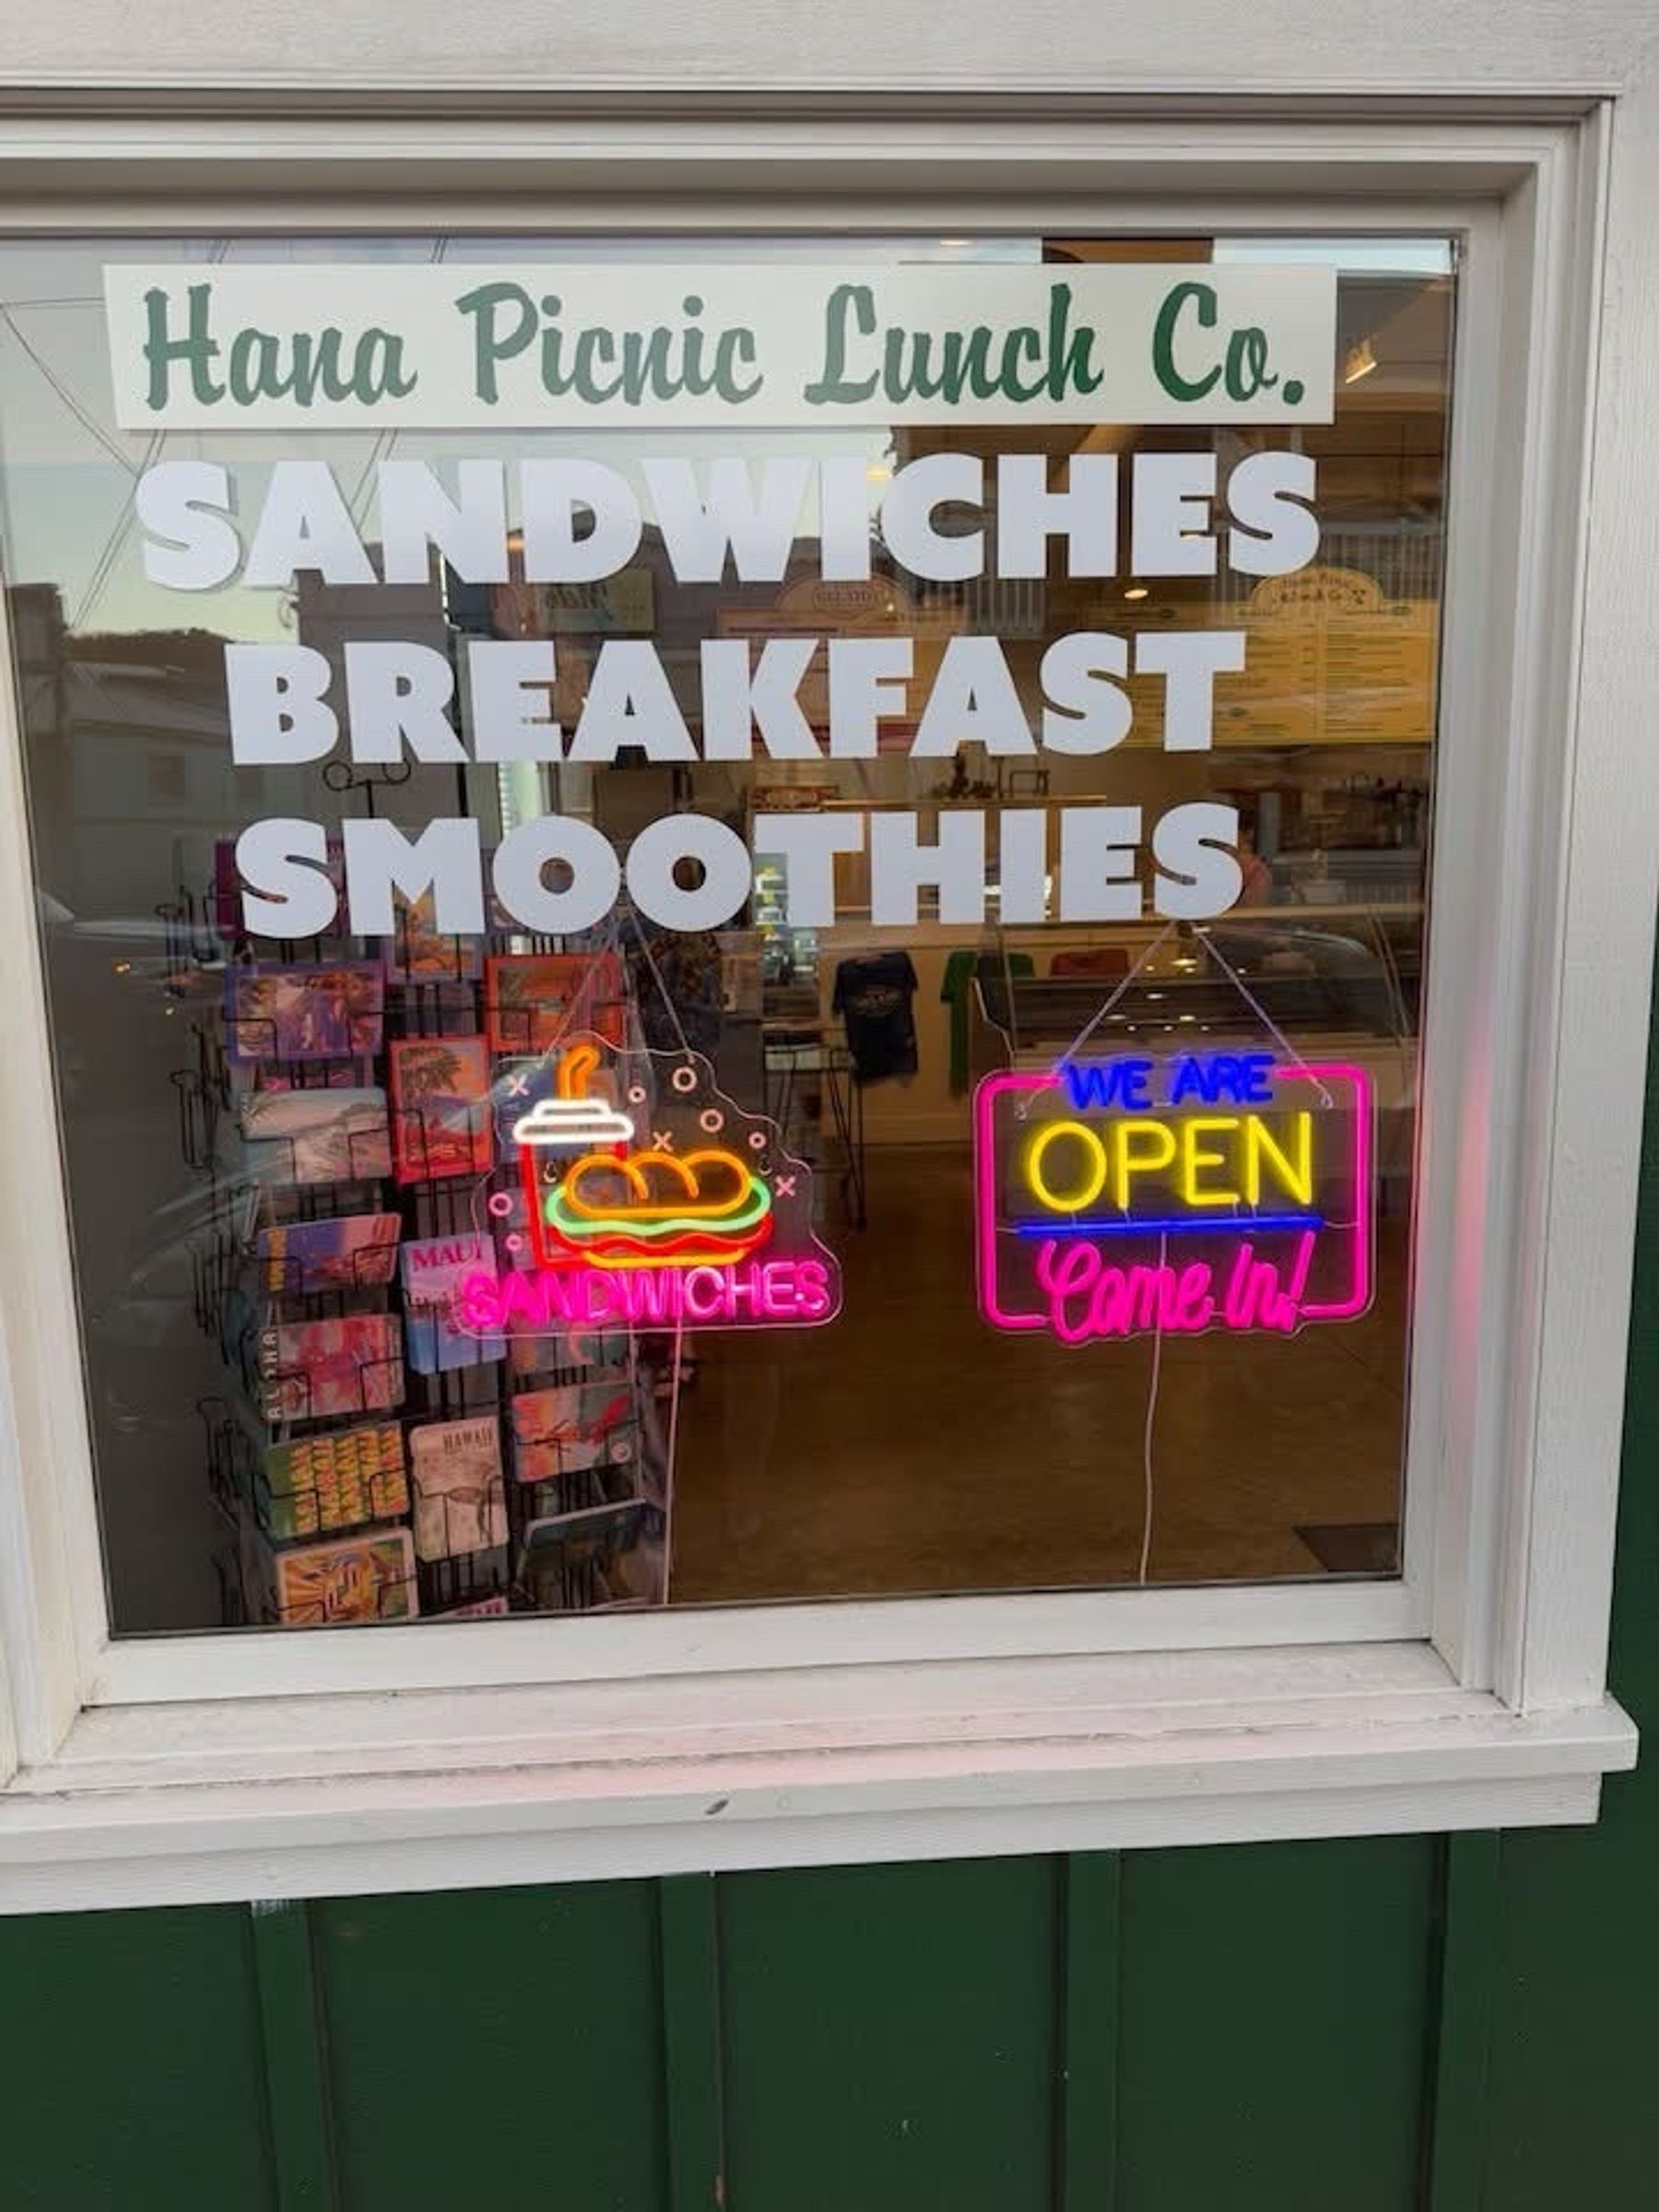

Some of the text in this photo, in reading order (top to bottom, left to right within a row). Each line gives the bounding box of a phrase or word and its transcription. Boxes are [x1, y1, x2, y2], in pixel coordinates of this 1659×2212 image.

[143, 281, 1306, 411] Hana Picnic Lunch Co.
[135, 452, 1320, 592] SANDWICHES
[224, 630, 1246, 766] BREAKFAST
[234, 802, 1243, 938] SMOOTHIES
[1062, 1053, 1276, 1110] WE ARE
[1028, 1111, 1313, 1214] OPEN
[409, 1238, 481, 1272] MAUI
[463, 1261, 830, 1329] SANDWICHES
[1038, 1231, 1316, 1344] Come In!
